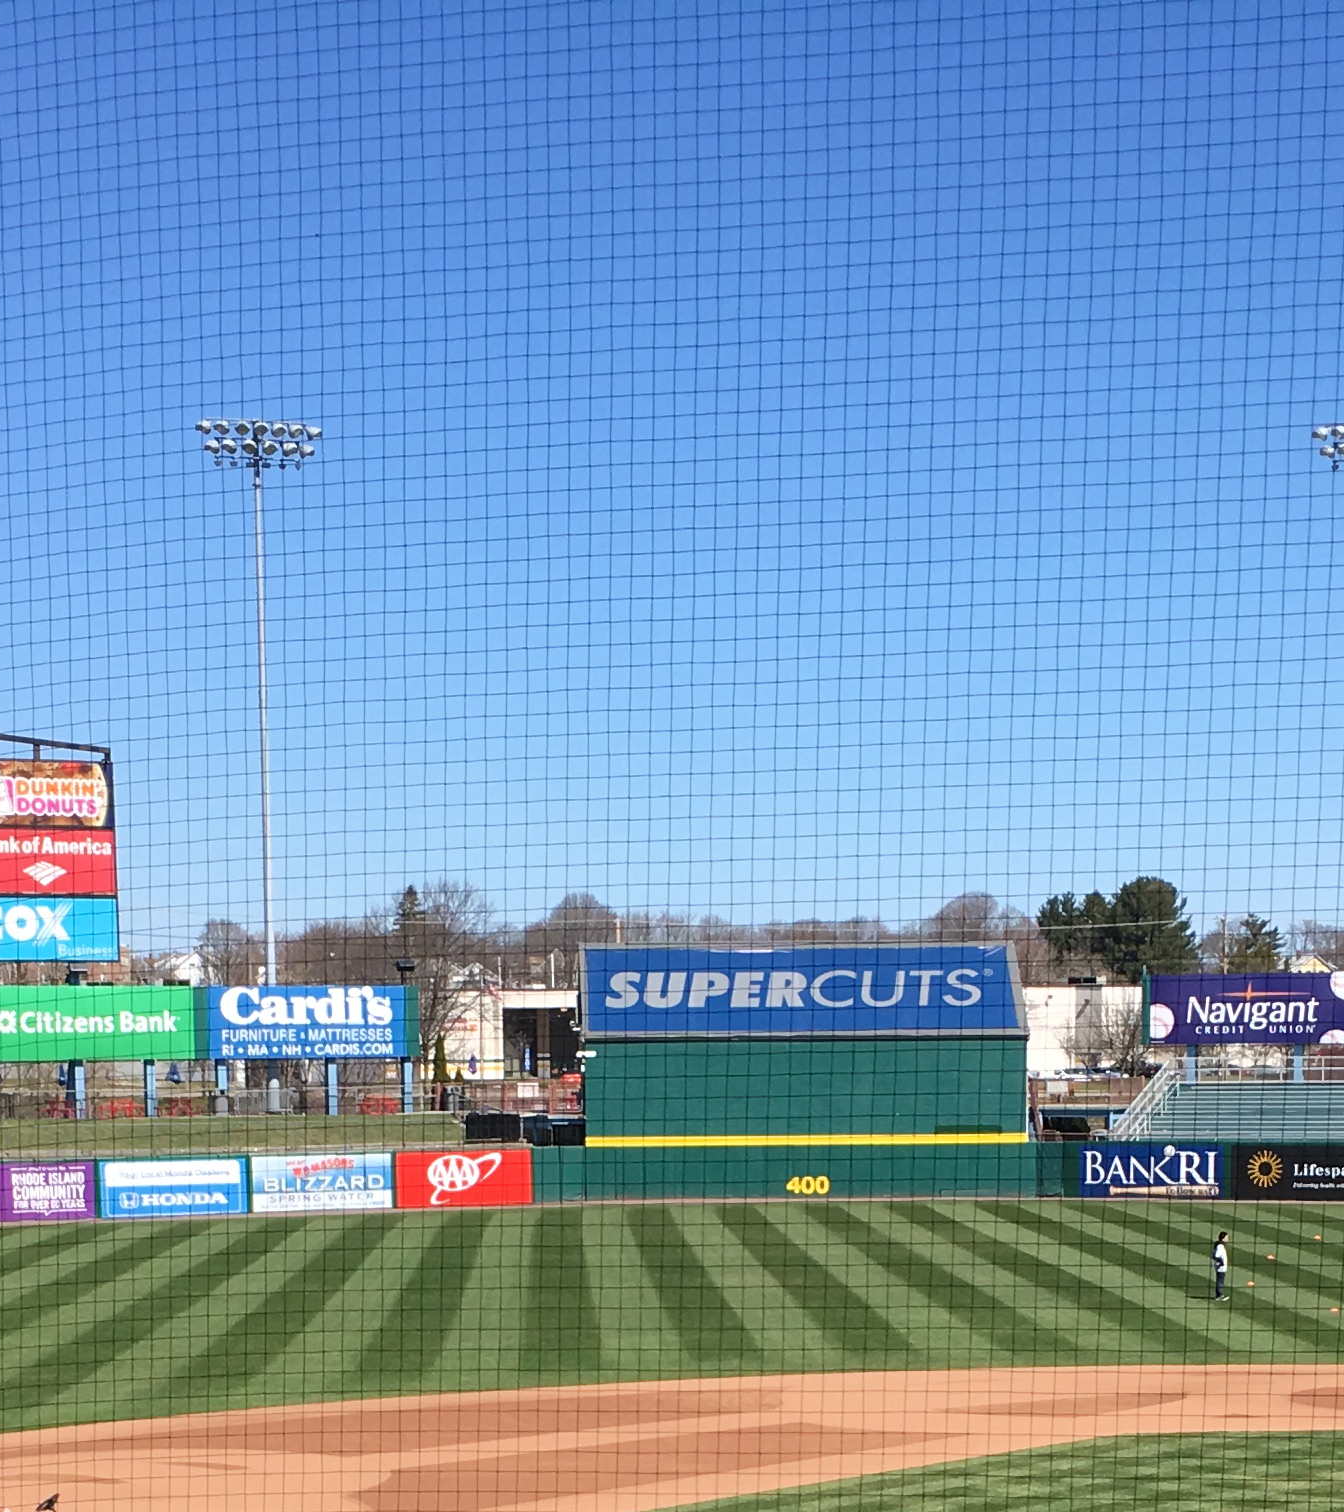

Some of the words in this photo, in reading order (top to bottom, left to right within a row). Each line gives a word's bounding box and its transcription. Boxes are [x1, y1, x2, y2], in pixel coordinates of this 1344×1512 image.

[16, 798, 96, 814] DONUTS
[22, 836, 40, 854] of
[42, 838, 111, 855] America
[605, 968, 982, 1009] SUPERCUTS
[220, 986, 393, 1026] Cardi's
[1187, 996, 1319, 1029] Navigant
[20, 1011, 115, 1033] Citizens
[120, 1010, 176, 1033] Bank
[1196, 1026, 1245, 1035] CREDIT
[1269, 1025, 1312, 1034] UNION
[222, 1028, 297, 1042] FURNITURE
[308, 1028, 392, 1041] MATTRESSES
[222, 1044, 234, 1056] RI
[248, 1044, 268, 1056] MA
[282, 1044, 301, 1056] NH
[314, 1042, 393, 1056] CARDIS.COM
[12, 1172, 45, 1186] RHODE
[48, 1172, 84, 1185] ISLAND
[433, 1160, 480, 1184] AAA
[264, 1174, 384, 1192] BLIZZARD
[786, 1176, 830, 1195] 400
[12, 1185, 85, 1200] COMMUNITY
[142, 1192, 228, 1206] HONDA
[269, 1194, 321, 1203] SPRING
[328, 1192, 374, 1201] WATER
